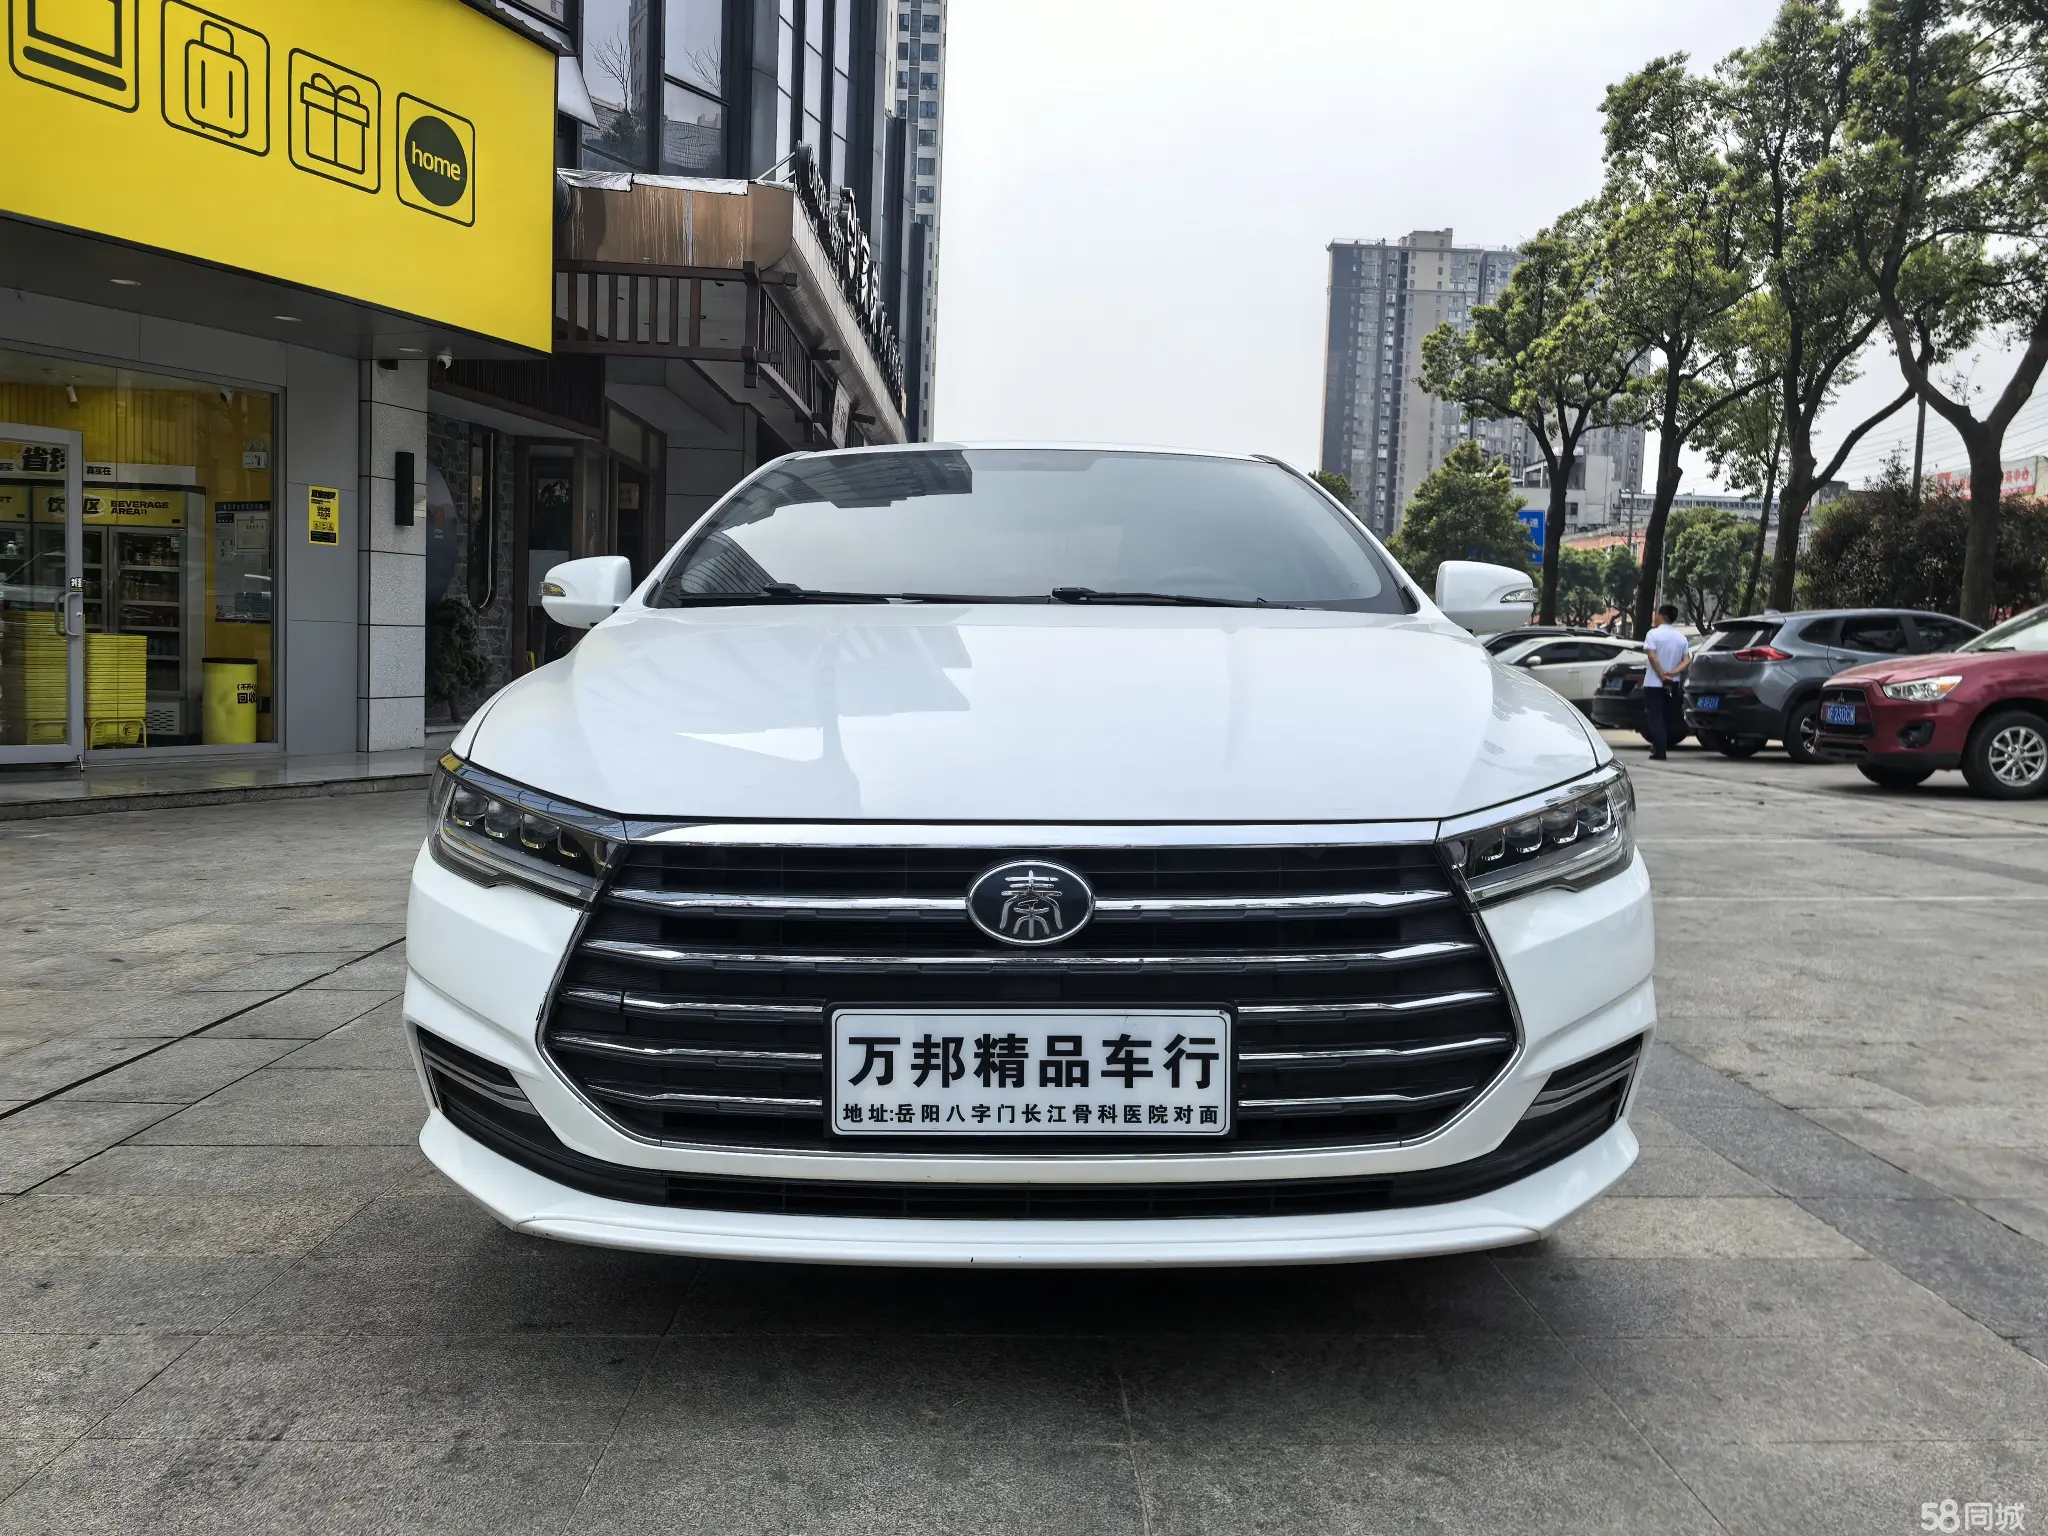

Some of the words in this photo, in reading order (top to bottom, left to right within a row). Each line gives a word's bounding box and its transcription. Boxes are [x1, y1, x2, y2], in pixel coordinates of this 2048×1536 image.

[411, 140, 461, 181] home
[110, 500, 170, 509] BEVERAGE
[847, 1032, 1220, 1090] 万邦精品车行
[842, 1103, 1219, 1124] 地址:岳阳八字门长江骨科医院对面
